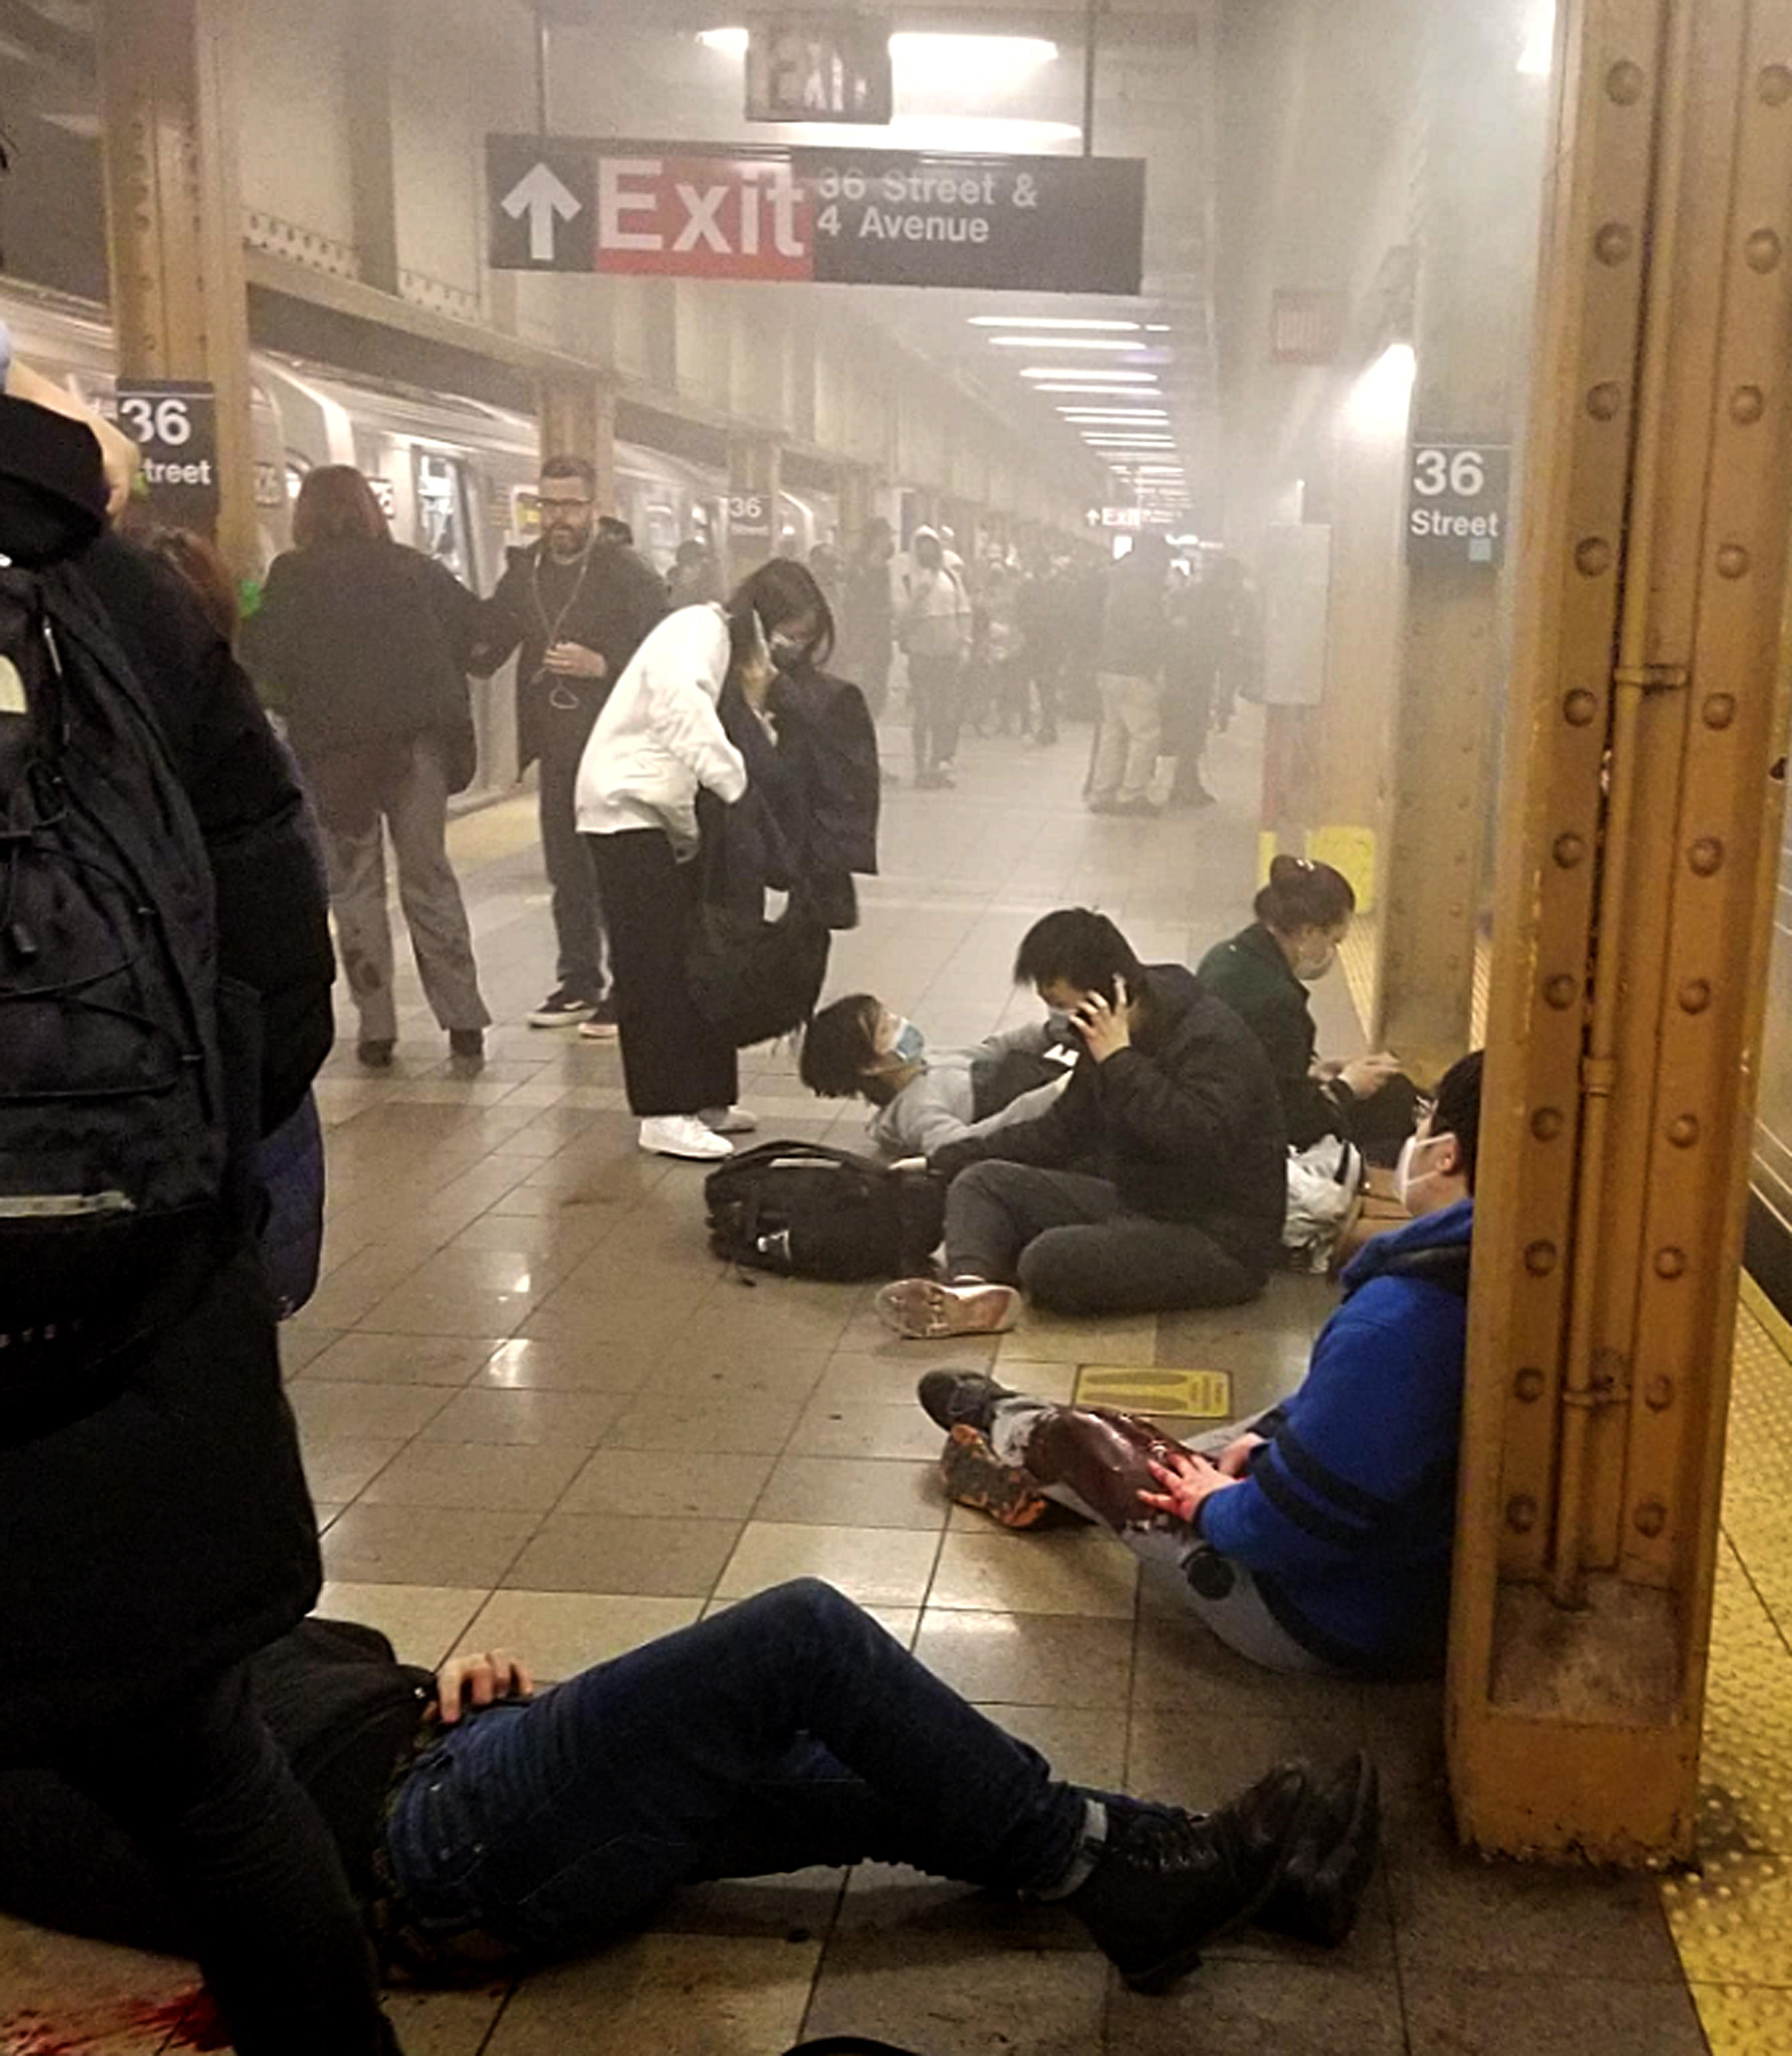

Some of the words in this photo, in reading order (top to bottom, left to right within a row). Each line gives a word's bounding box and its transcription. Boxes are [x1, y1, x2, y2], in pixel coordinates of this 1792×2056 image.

[818, 167, 867, 200] 36
[882, 169, 997, 205] Street
[1012, 172, 1037, 208] &
[600, 159, 805, 258] Exit
[817, 204, 842, 236] 4
[859, 205, 990, 243] Avenue
[120, 398, 191, 446] 36
[143, 458, 211, 485] treet
[1413, 449, 1485, 496] 36
[729, 497, 762, 518] 36
[1411, 509, 1499, 537] Street
